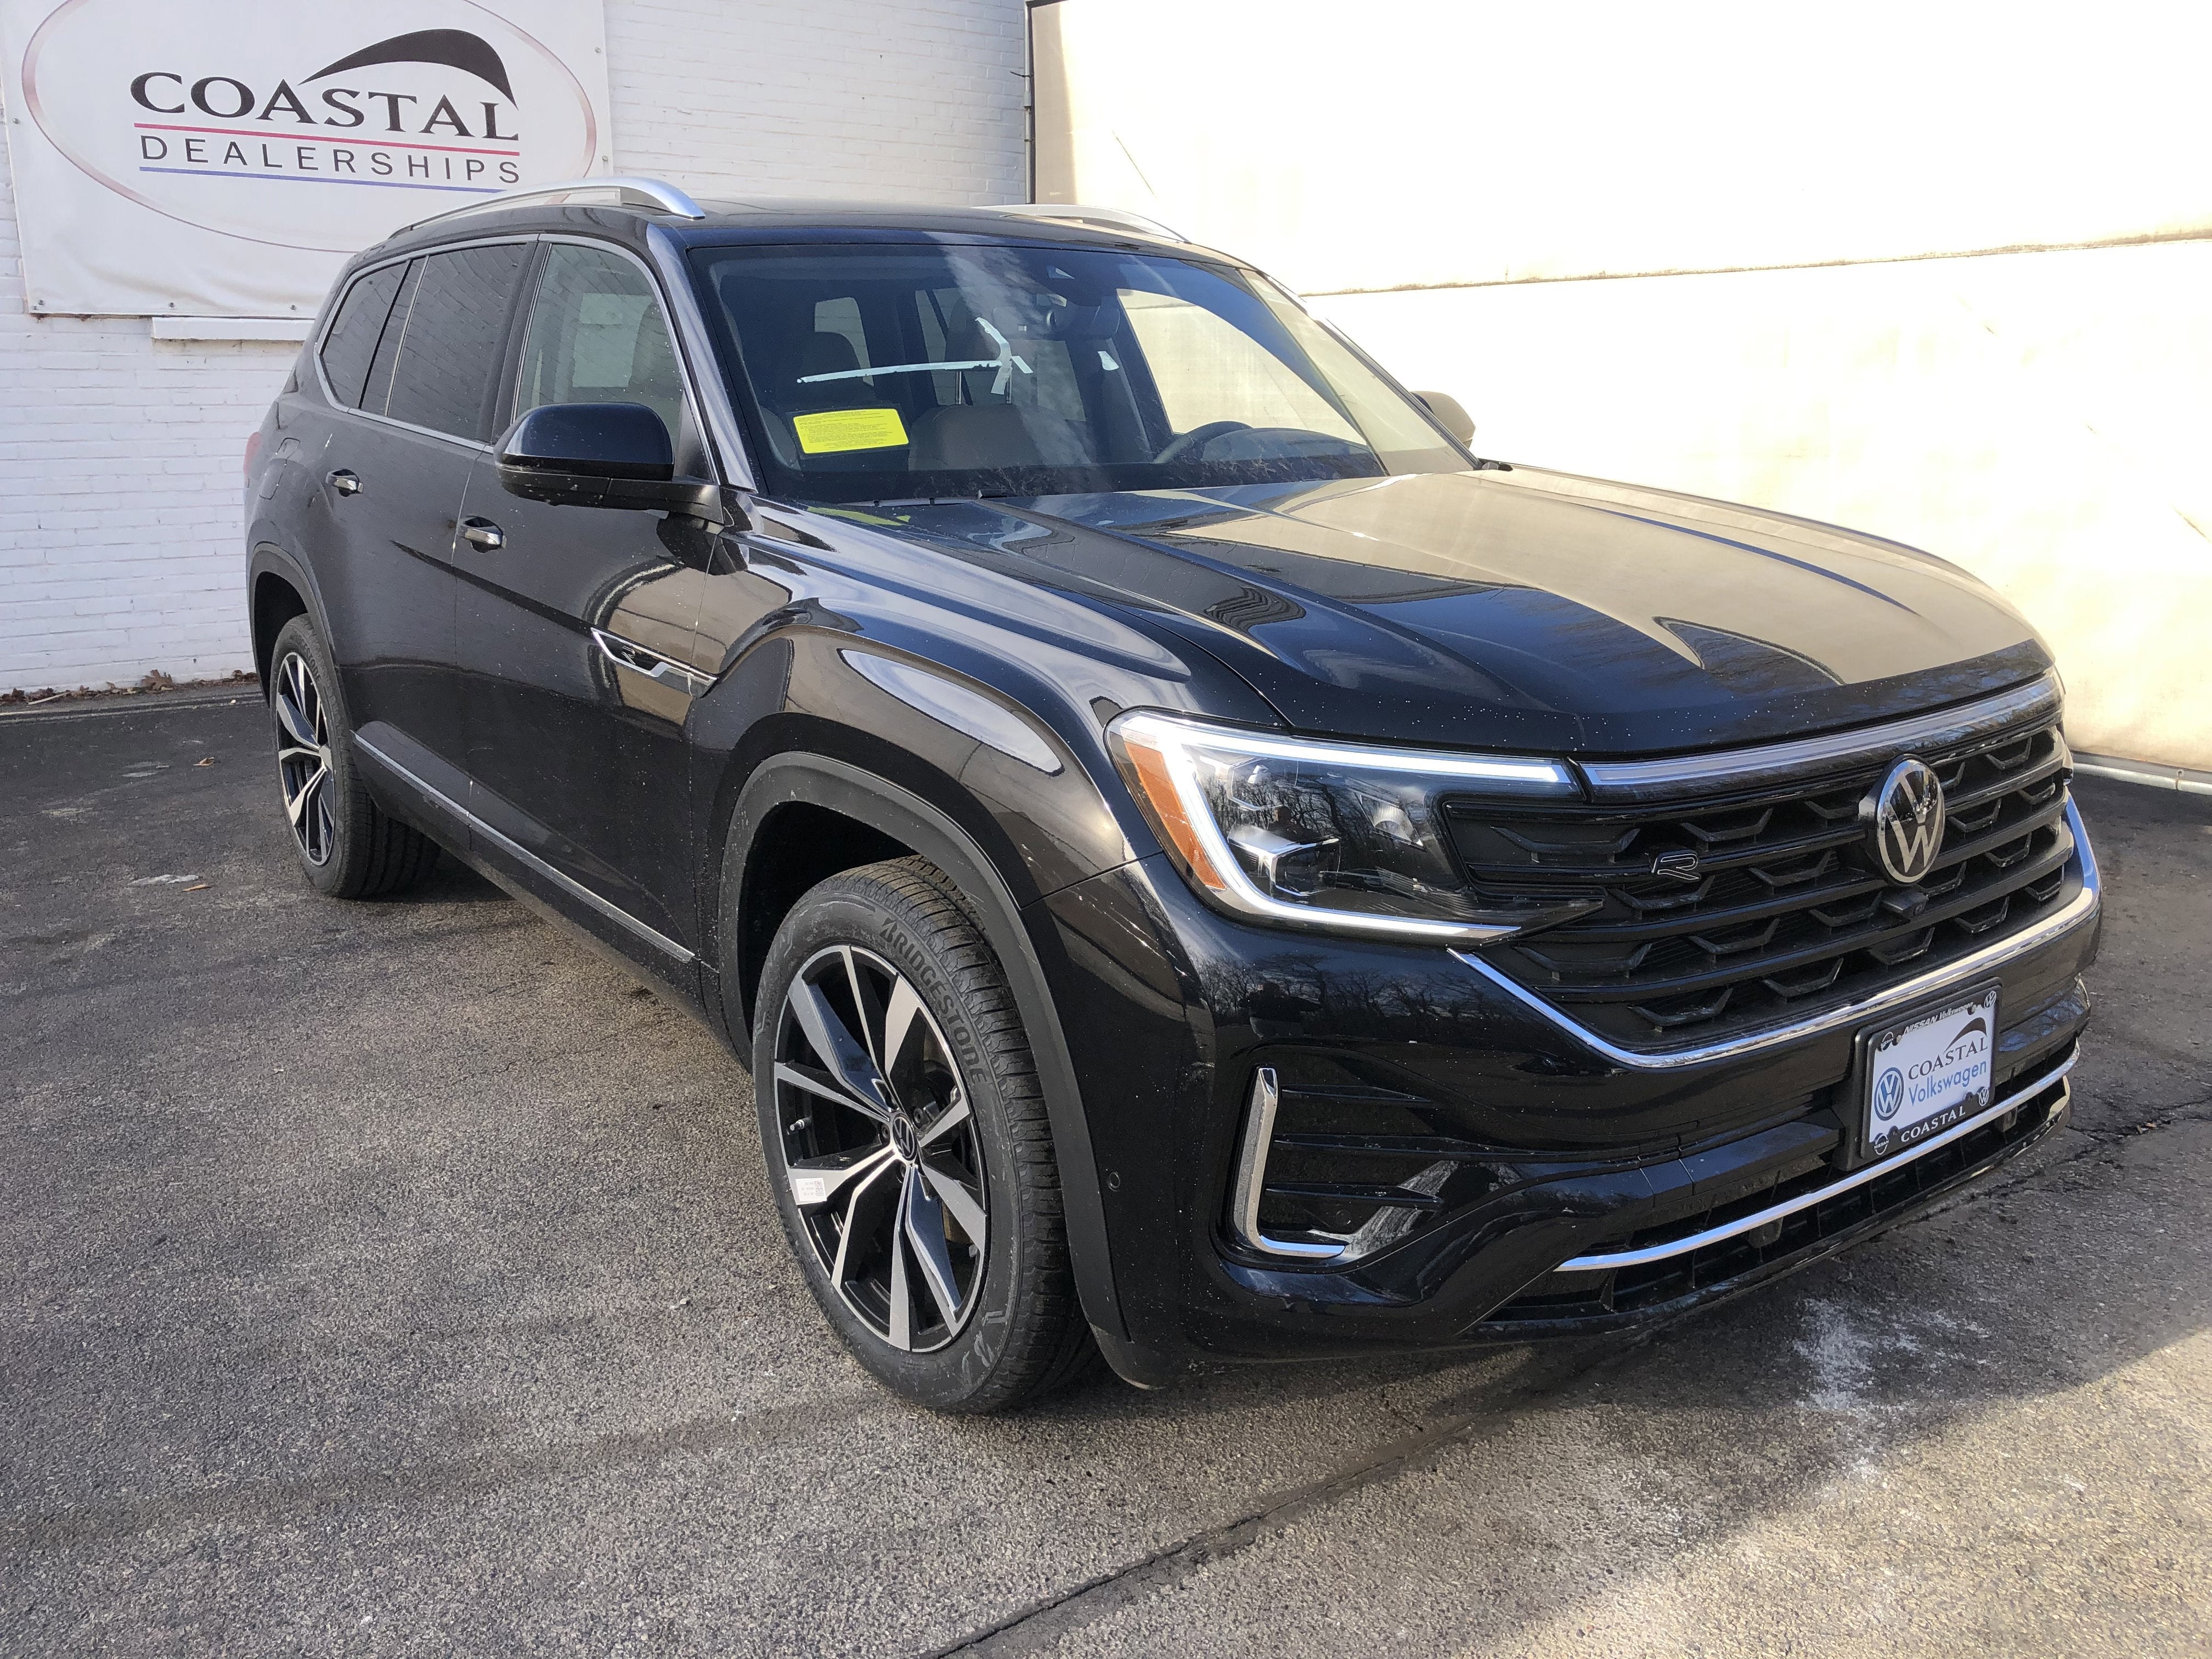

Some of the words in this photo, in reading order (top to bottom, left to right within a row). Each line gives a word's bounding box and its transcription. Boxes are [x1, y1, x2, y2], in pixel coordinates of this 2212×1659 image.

[131, 72, 519, 141] COASTAL
[141, 136, 520, 183] DEALERSHIPS
[879, 917, 988, 1084] BRIDGESTONE
[1904, 1014, 1938, 1034] NISSAN
[1908, 1037, 1988, 1080] COASTAL
[1909, 1060, 1987, 1106] Volkswagen
[1901, 1106, 1966, 1142] COASTAL
